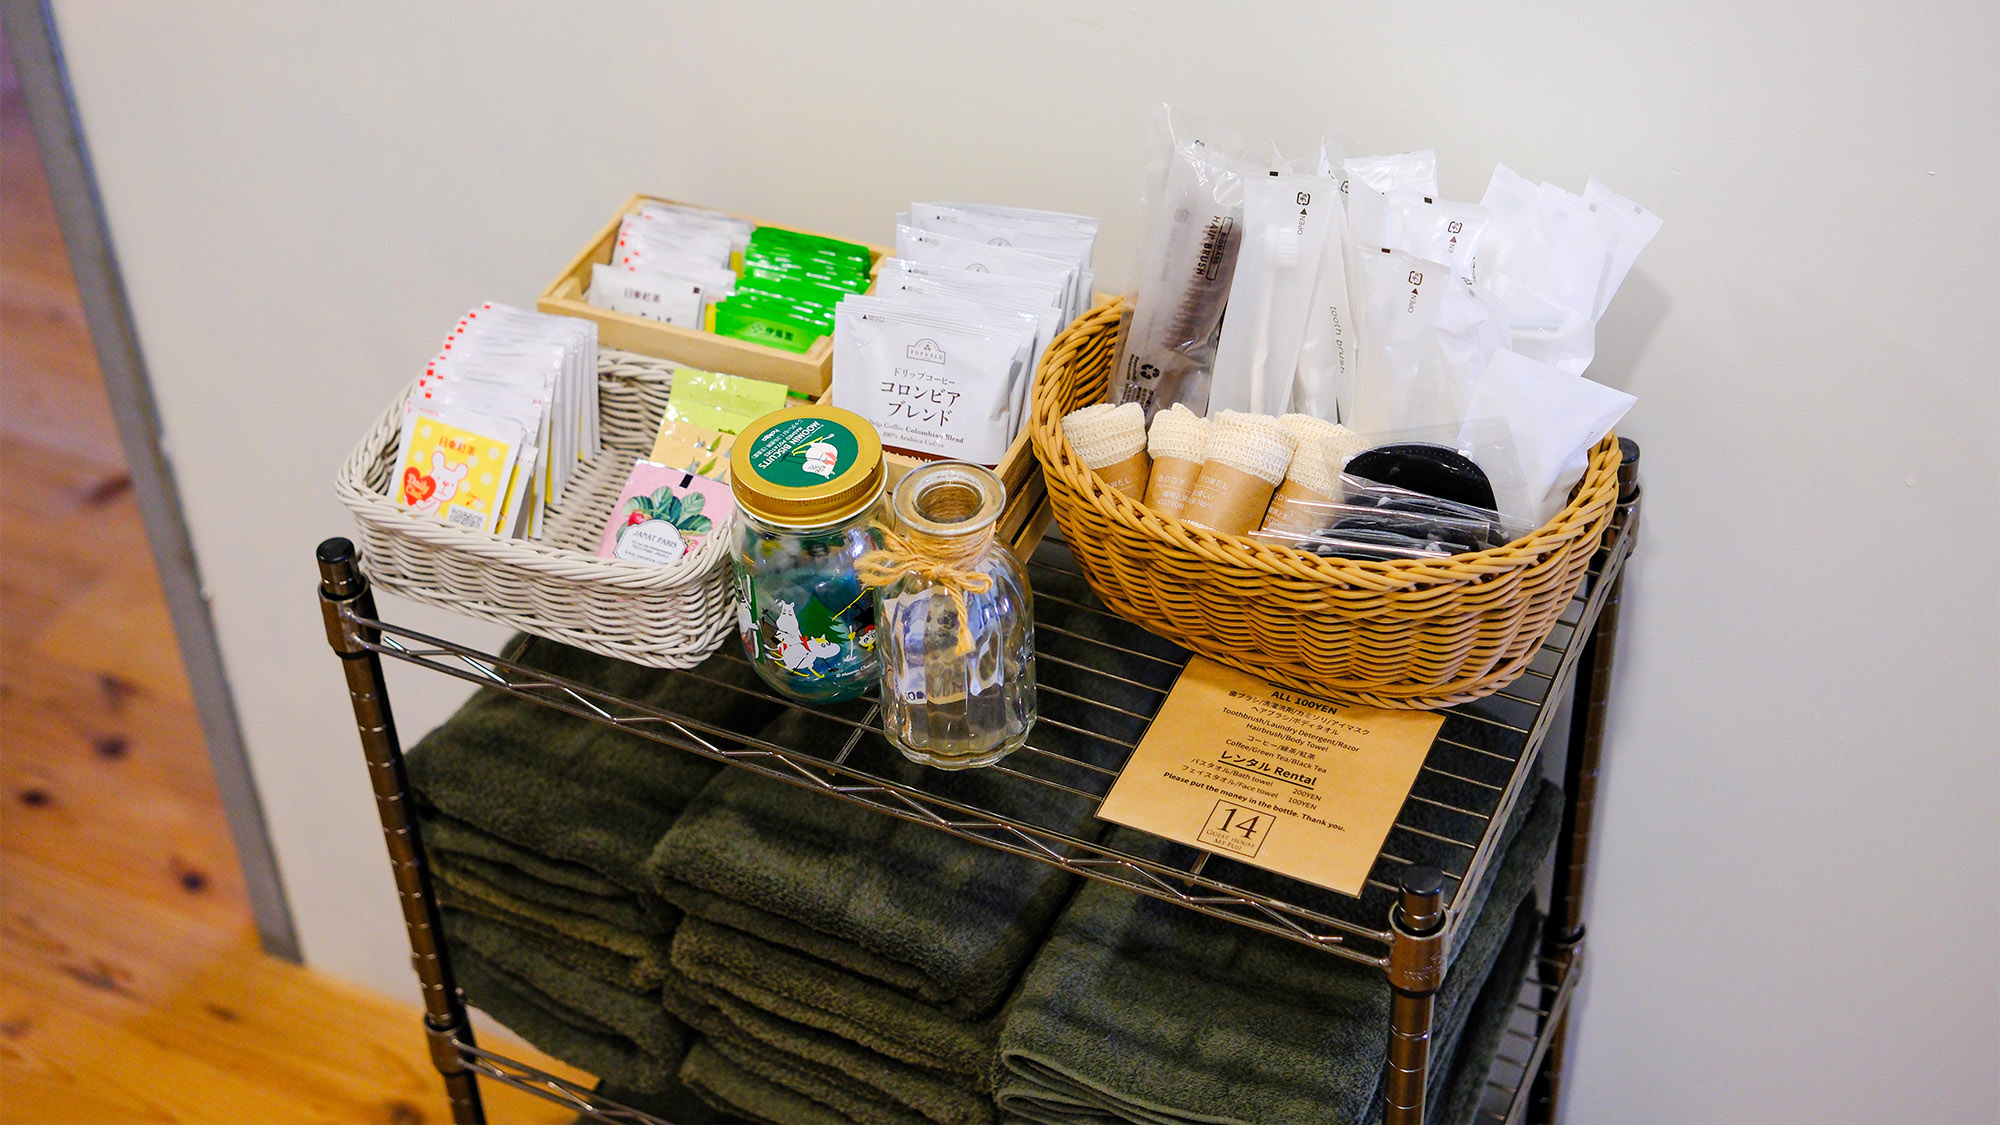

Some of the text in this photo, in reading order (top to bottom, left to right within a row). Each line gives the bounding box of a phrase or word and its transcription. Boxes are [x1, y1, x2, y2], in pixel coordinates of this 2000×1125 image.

[1297, 215, 1306, 235] OPEN
[1196, 243, 1211, 276] BRUSH
[1408, 295, 1416, 313] OPEN
[1330, 306, 1342, 336] tooth
[765, 327, 793, 341] 伊藤園
[910, 350, 943, 360] TOPVALU
[894, 367, 955, 385] ドリップコーヒー
[881, 381, 960, 407] コロンビア
[888, 400, 952, 427] ブレンド
[788, 420, 821, 445] MOOMIN
[882, 431, 898, 439] 100%
[900, 434, 923, 444] Arabica
[884, 422, 904, 431] Coffee
[905, 426, 943, 439] Colombian
[945, 434, 964, 444] Blend
[758, 444, 792, 469] BISCUITS
[1110, 477, 1132, 487] WEL
[1158, 475, 1184, 485] BODY
[1202, 475, 1227, 490] TOWEL
[1158, 498, 1184, 510] COTTON
[633, 530, 678, 548] JANAT PARIS
[1229, 690, 1370, 736] 歯ブラシ/洗濯洗剤/カミソリ/アイマスク
[1271, 691, 1337, 715] ALL 100YEN
[1223, 707, 1360, 752] Toothbrush/Laundry Detergent/Razor
[1251, 706, 1339, 736] ヘアブラシ/ボディタオル
[1246, 723, 1329, 752] Hairbrush/Body Towel
[1247, 735, 1316, 760] コーヒー/緑茶/紅茶
[1220, 750, 1317, 786] レンタル Rental
[1225, 738, 1327, 774] Coffee/Green Tea/Black Tea
[1181, 765, 1317, 811] フェイスタオル/Face towel 100YEN
[1191, 758, 1322, 802] バスタオル/Bath towel 200YEN
[1163, 771, 1346, 832] Please put the money in the bottle. Thank you.
[1217, 808, 1260, 840] 14
[1206, 829, 1255, 849] GUEST HOUSE
